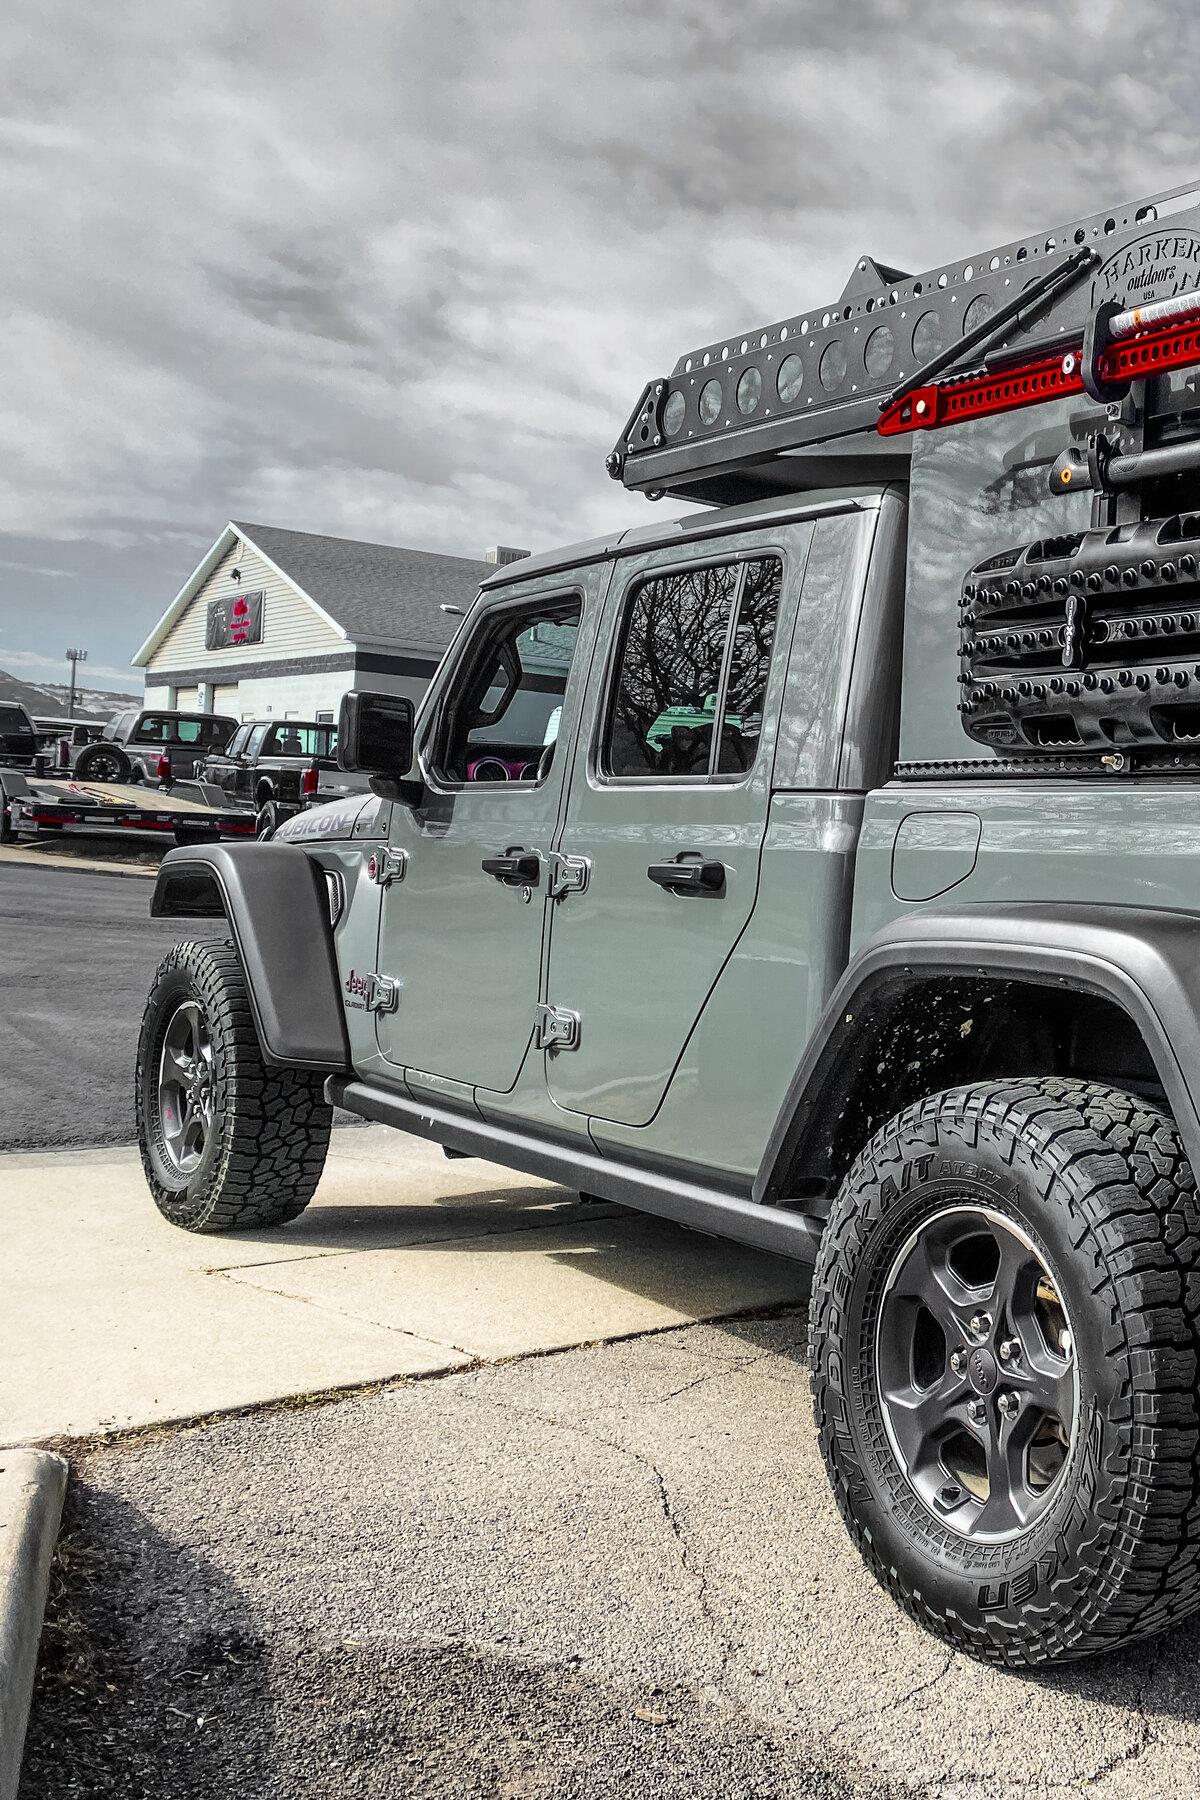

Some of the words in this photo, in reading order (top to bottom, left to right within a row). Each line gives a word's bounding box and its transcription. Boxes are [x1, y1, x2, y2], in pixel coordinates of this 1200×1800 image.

[1103, 237, 1200, 290] HARKER
[1126, 264, 1177, 292] outdoors
[1143, 291, 1155, 301] USA
[879, 1151, 937, 1215] A/T
[939, 1159, 1002, 1185] AT3W
